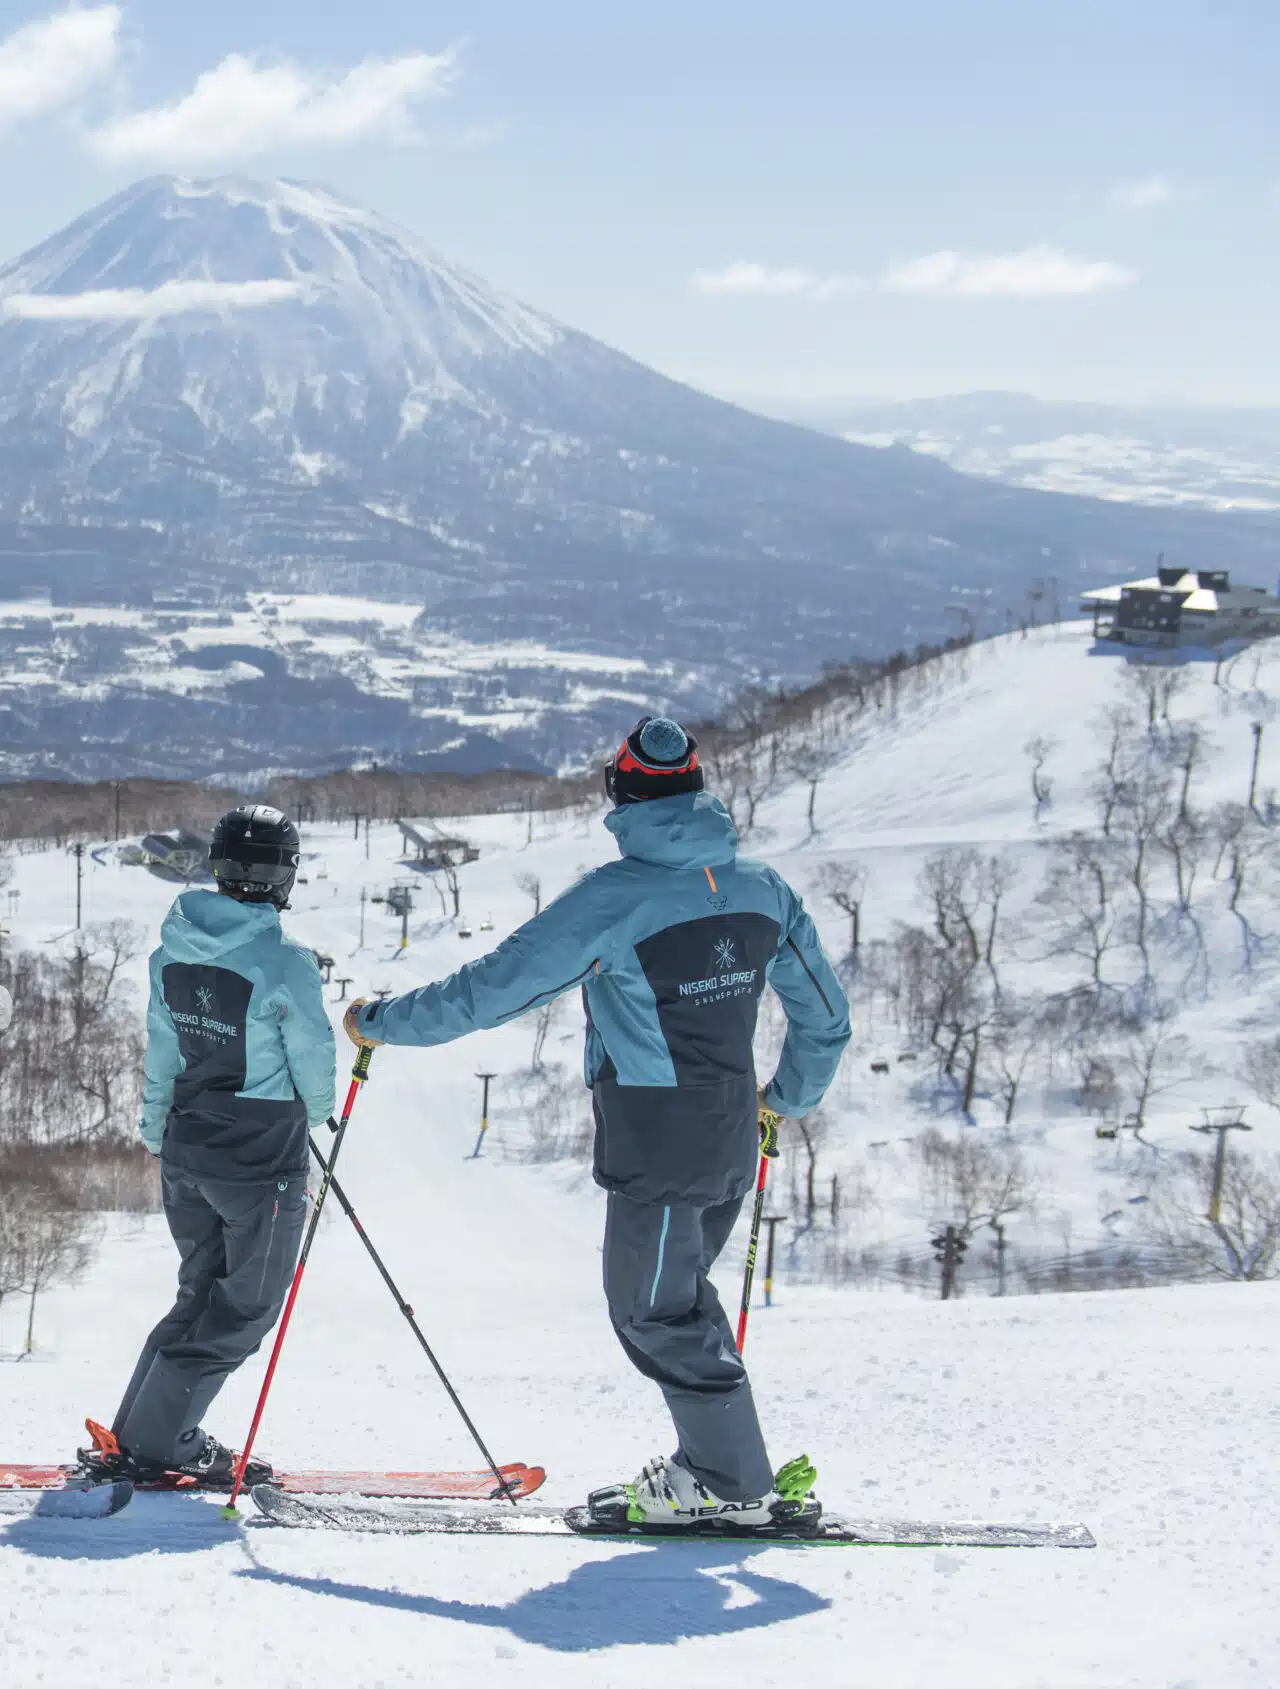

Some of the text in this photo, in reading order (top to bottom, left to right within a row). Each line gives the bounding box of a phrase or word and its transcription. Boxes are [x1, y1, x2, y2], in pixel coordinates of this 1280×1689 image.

[679, 977, 718, 996] NISEKO
[201, 1016, 238, 1037] SUPREME
[179, 1466, 208, 1474] ATOMIC
[674, 1500, 763, 1517] HEAD
